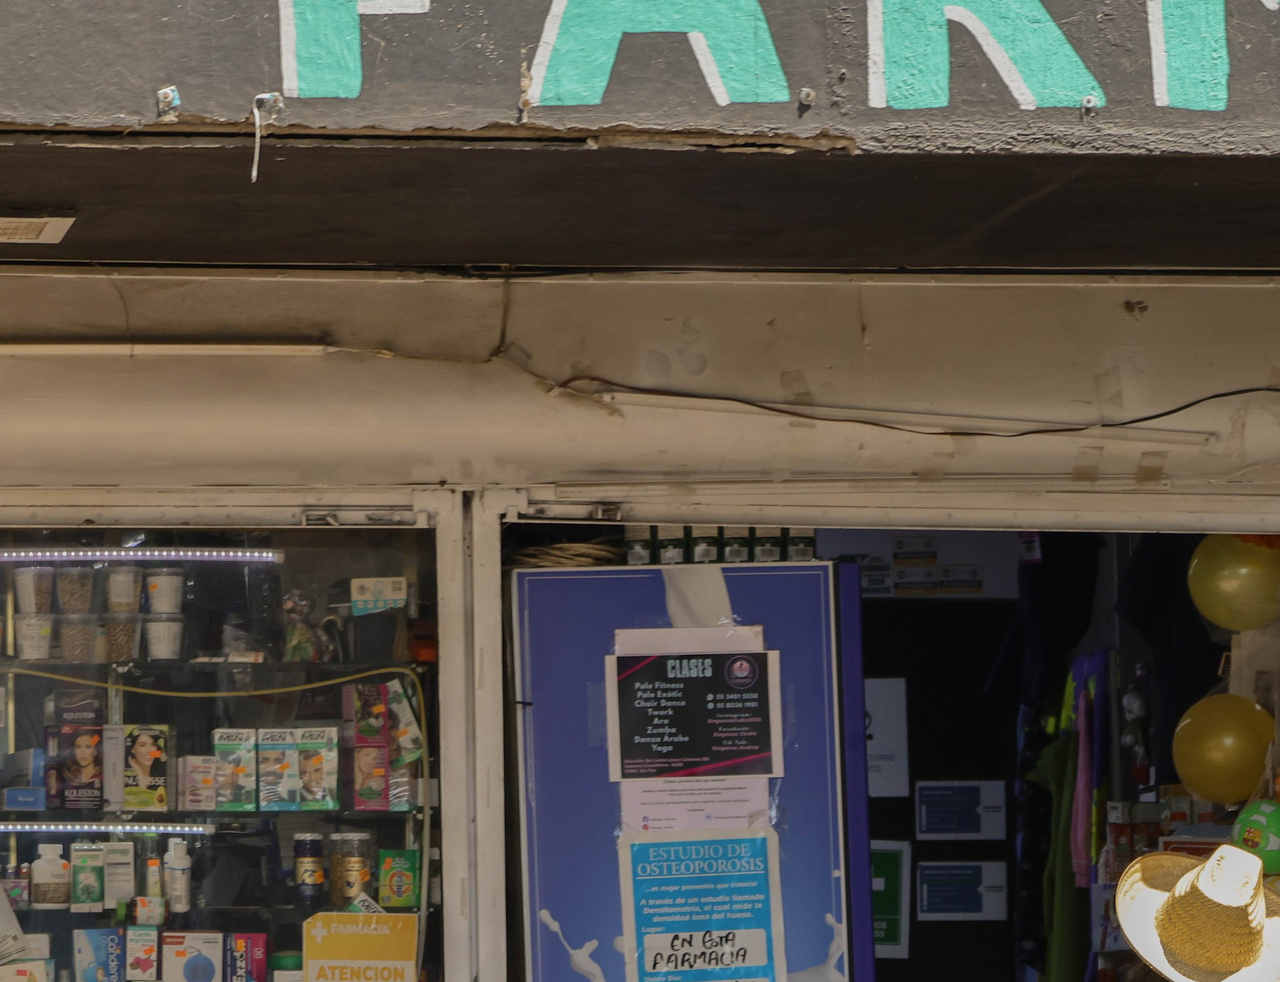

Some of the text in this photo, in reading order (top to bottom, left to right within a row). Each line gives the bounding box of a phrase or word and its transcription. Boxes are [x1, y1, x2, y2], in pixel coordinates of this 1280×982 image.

[666, 659, 713, 678] CLASES
[649, 843, 751, 861] ESTUDIO DE
[636, 857, 765, 876] OSTEOPOROSIS
[675, 896, 686, 904] de
[331, 923, 390, 935] FARMACIA
[652, 947, 747, 970] FARMACIA
[315, 965, 405, 982] ATENCION
